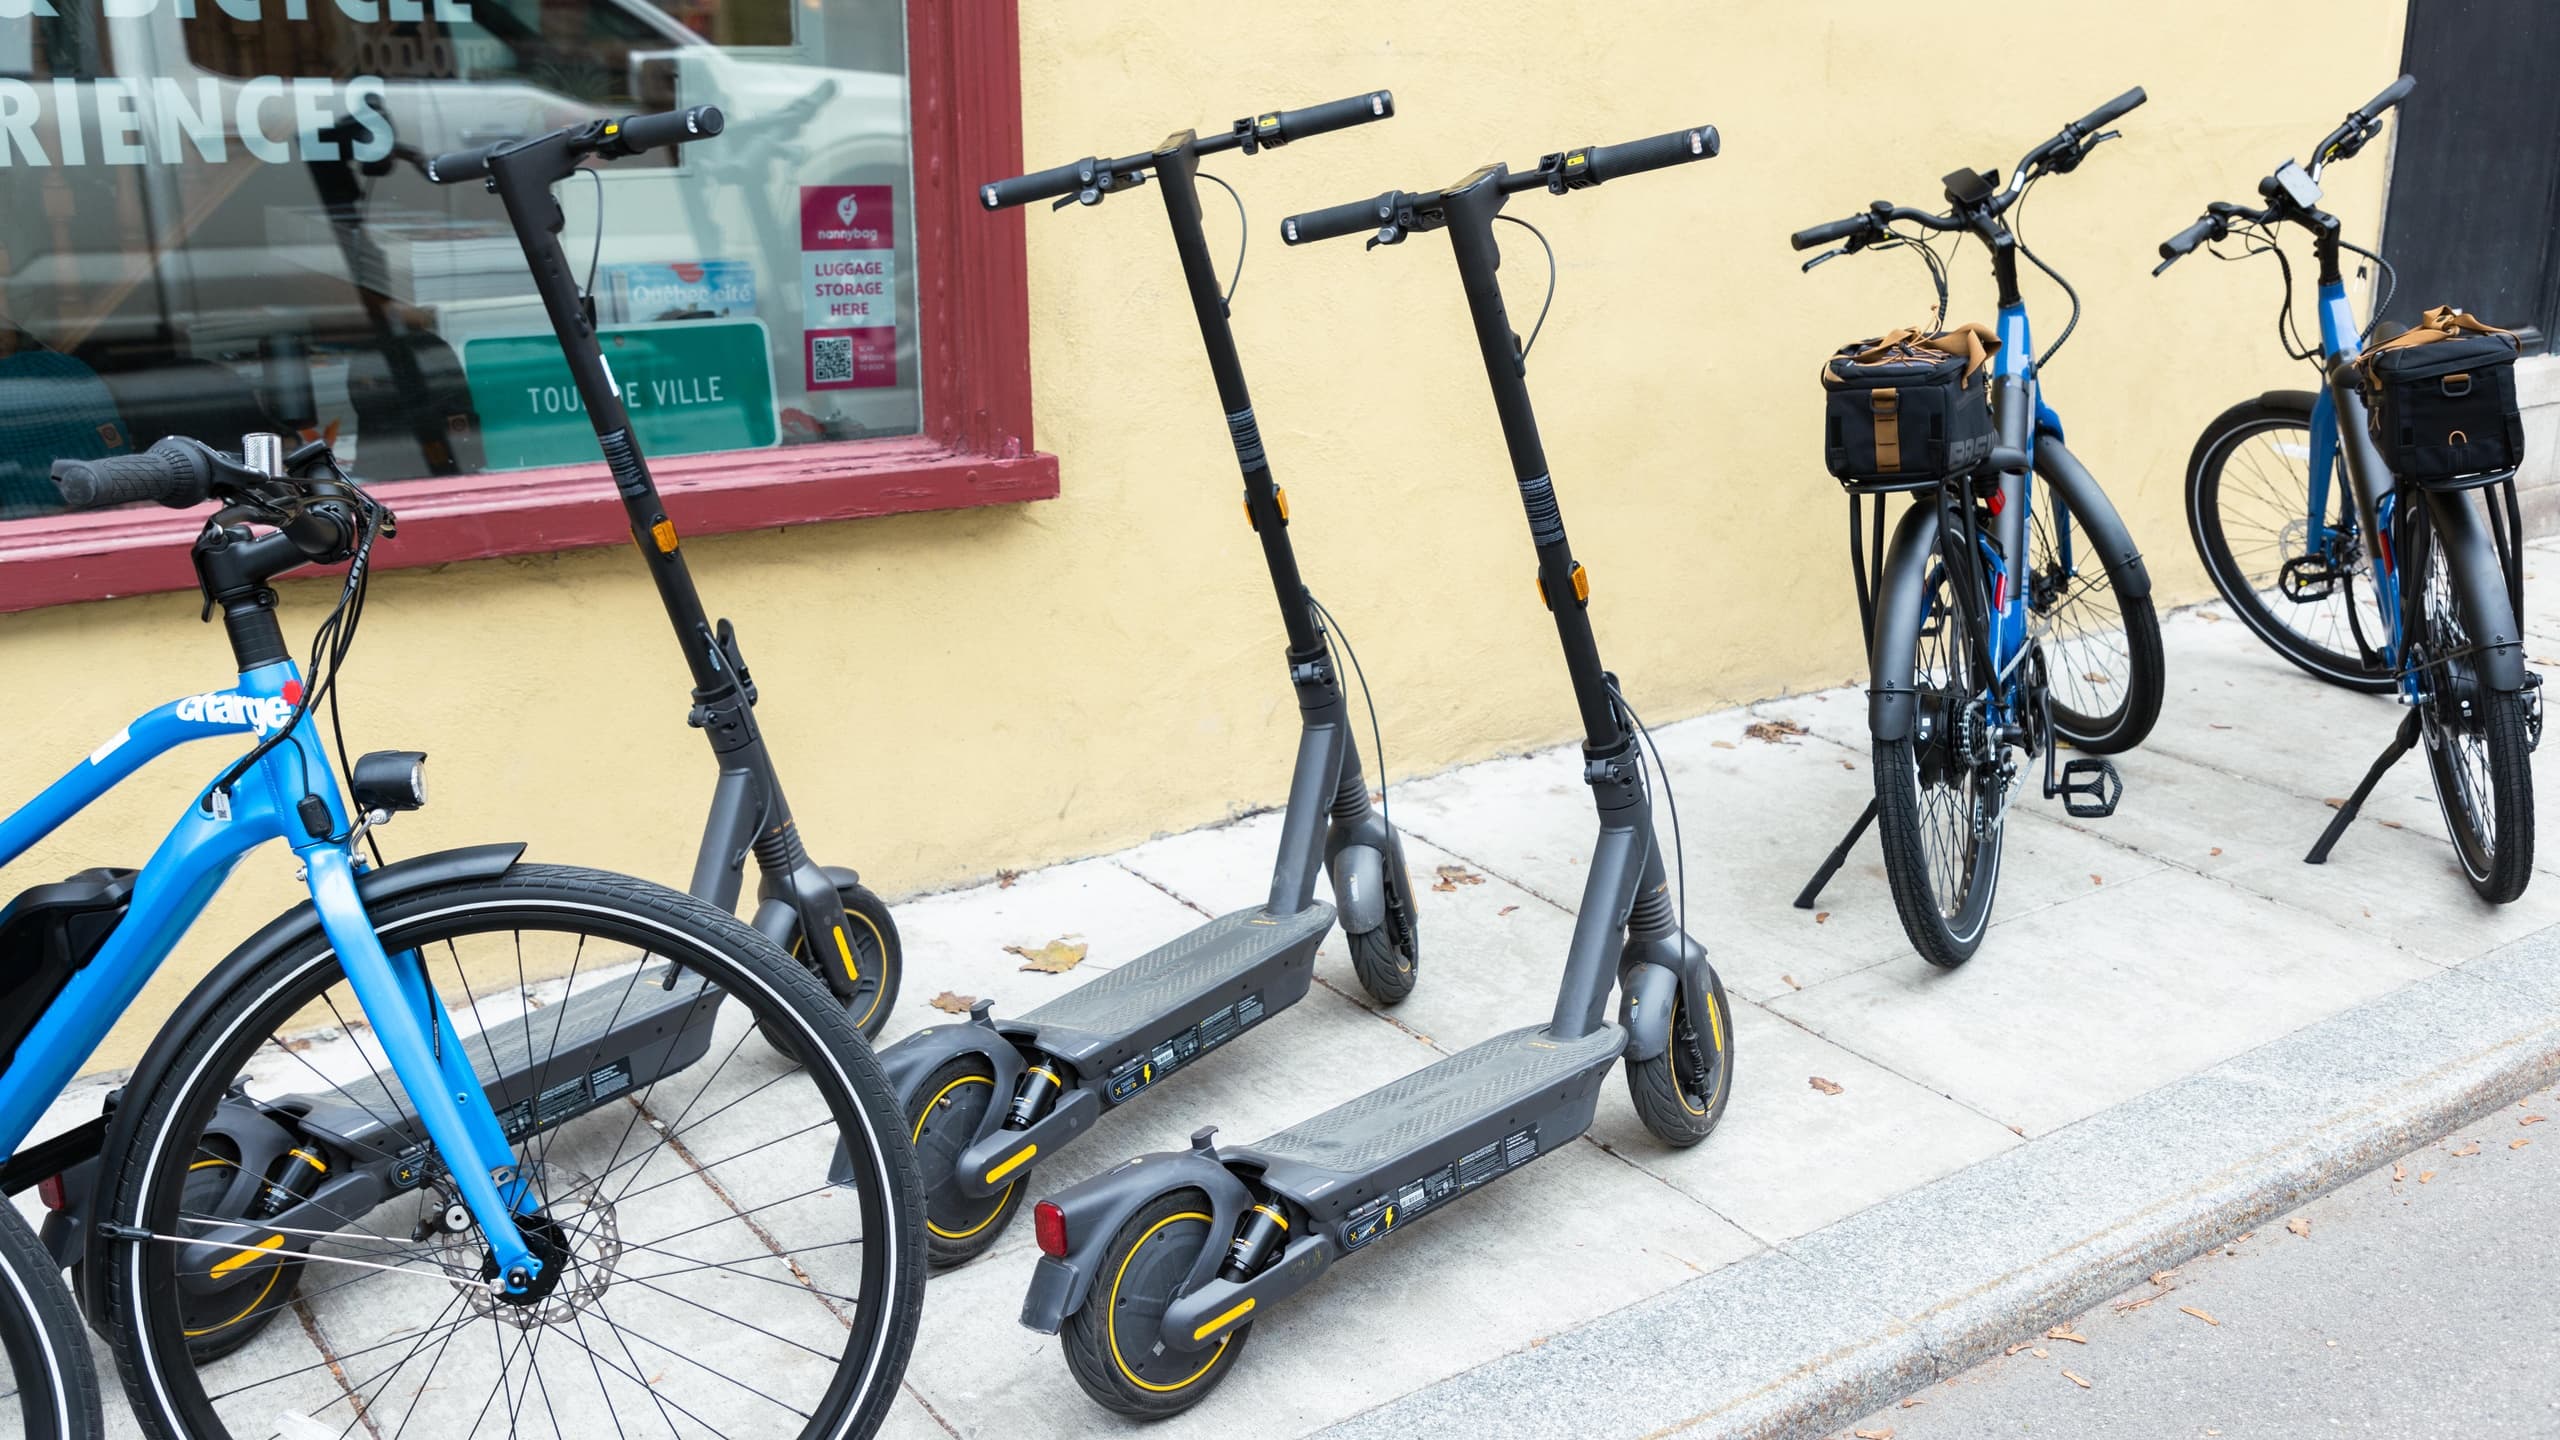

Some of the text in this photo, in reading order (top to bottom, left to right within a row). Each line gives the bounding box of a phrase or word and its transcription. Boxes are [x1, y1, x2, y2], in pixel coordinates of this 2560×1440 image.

[0, 75, 394, 167] RIENCES
[818, 228, 878, 242] nannybag
[815, 262, 883, 277] LUGGAGE
[815, 282, 883, 297] STORAGE
[831, 302, 870, 316] HERE
[527, 376, 724, 413] TOU E VILLE
